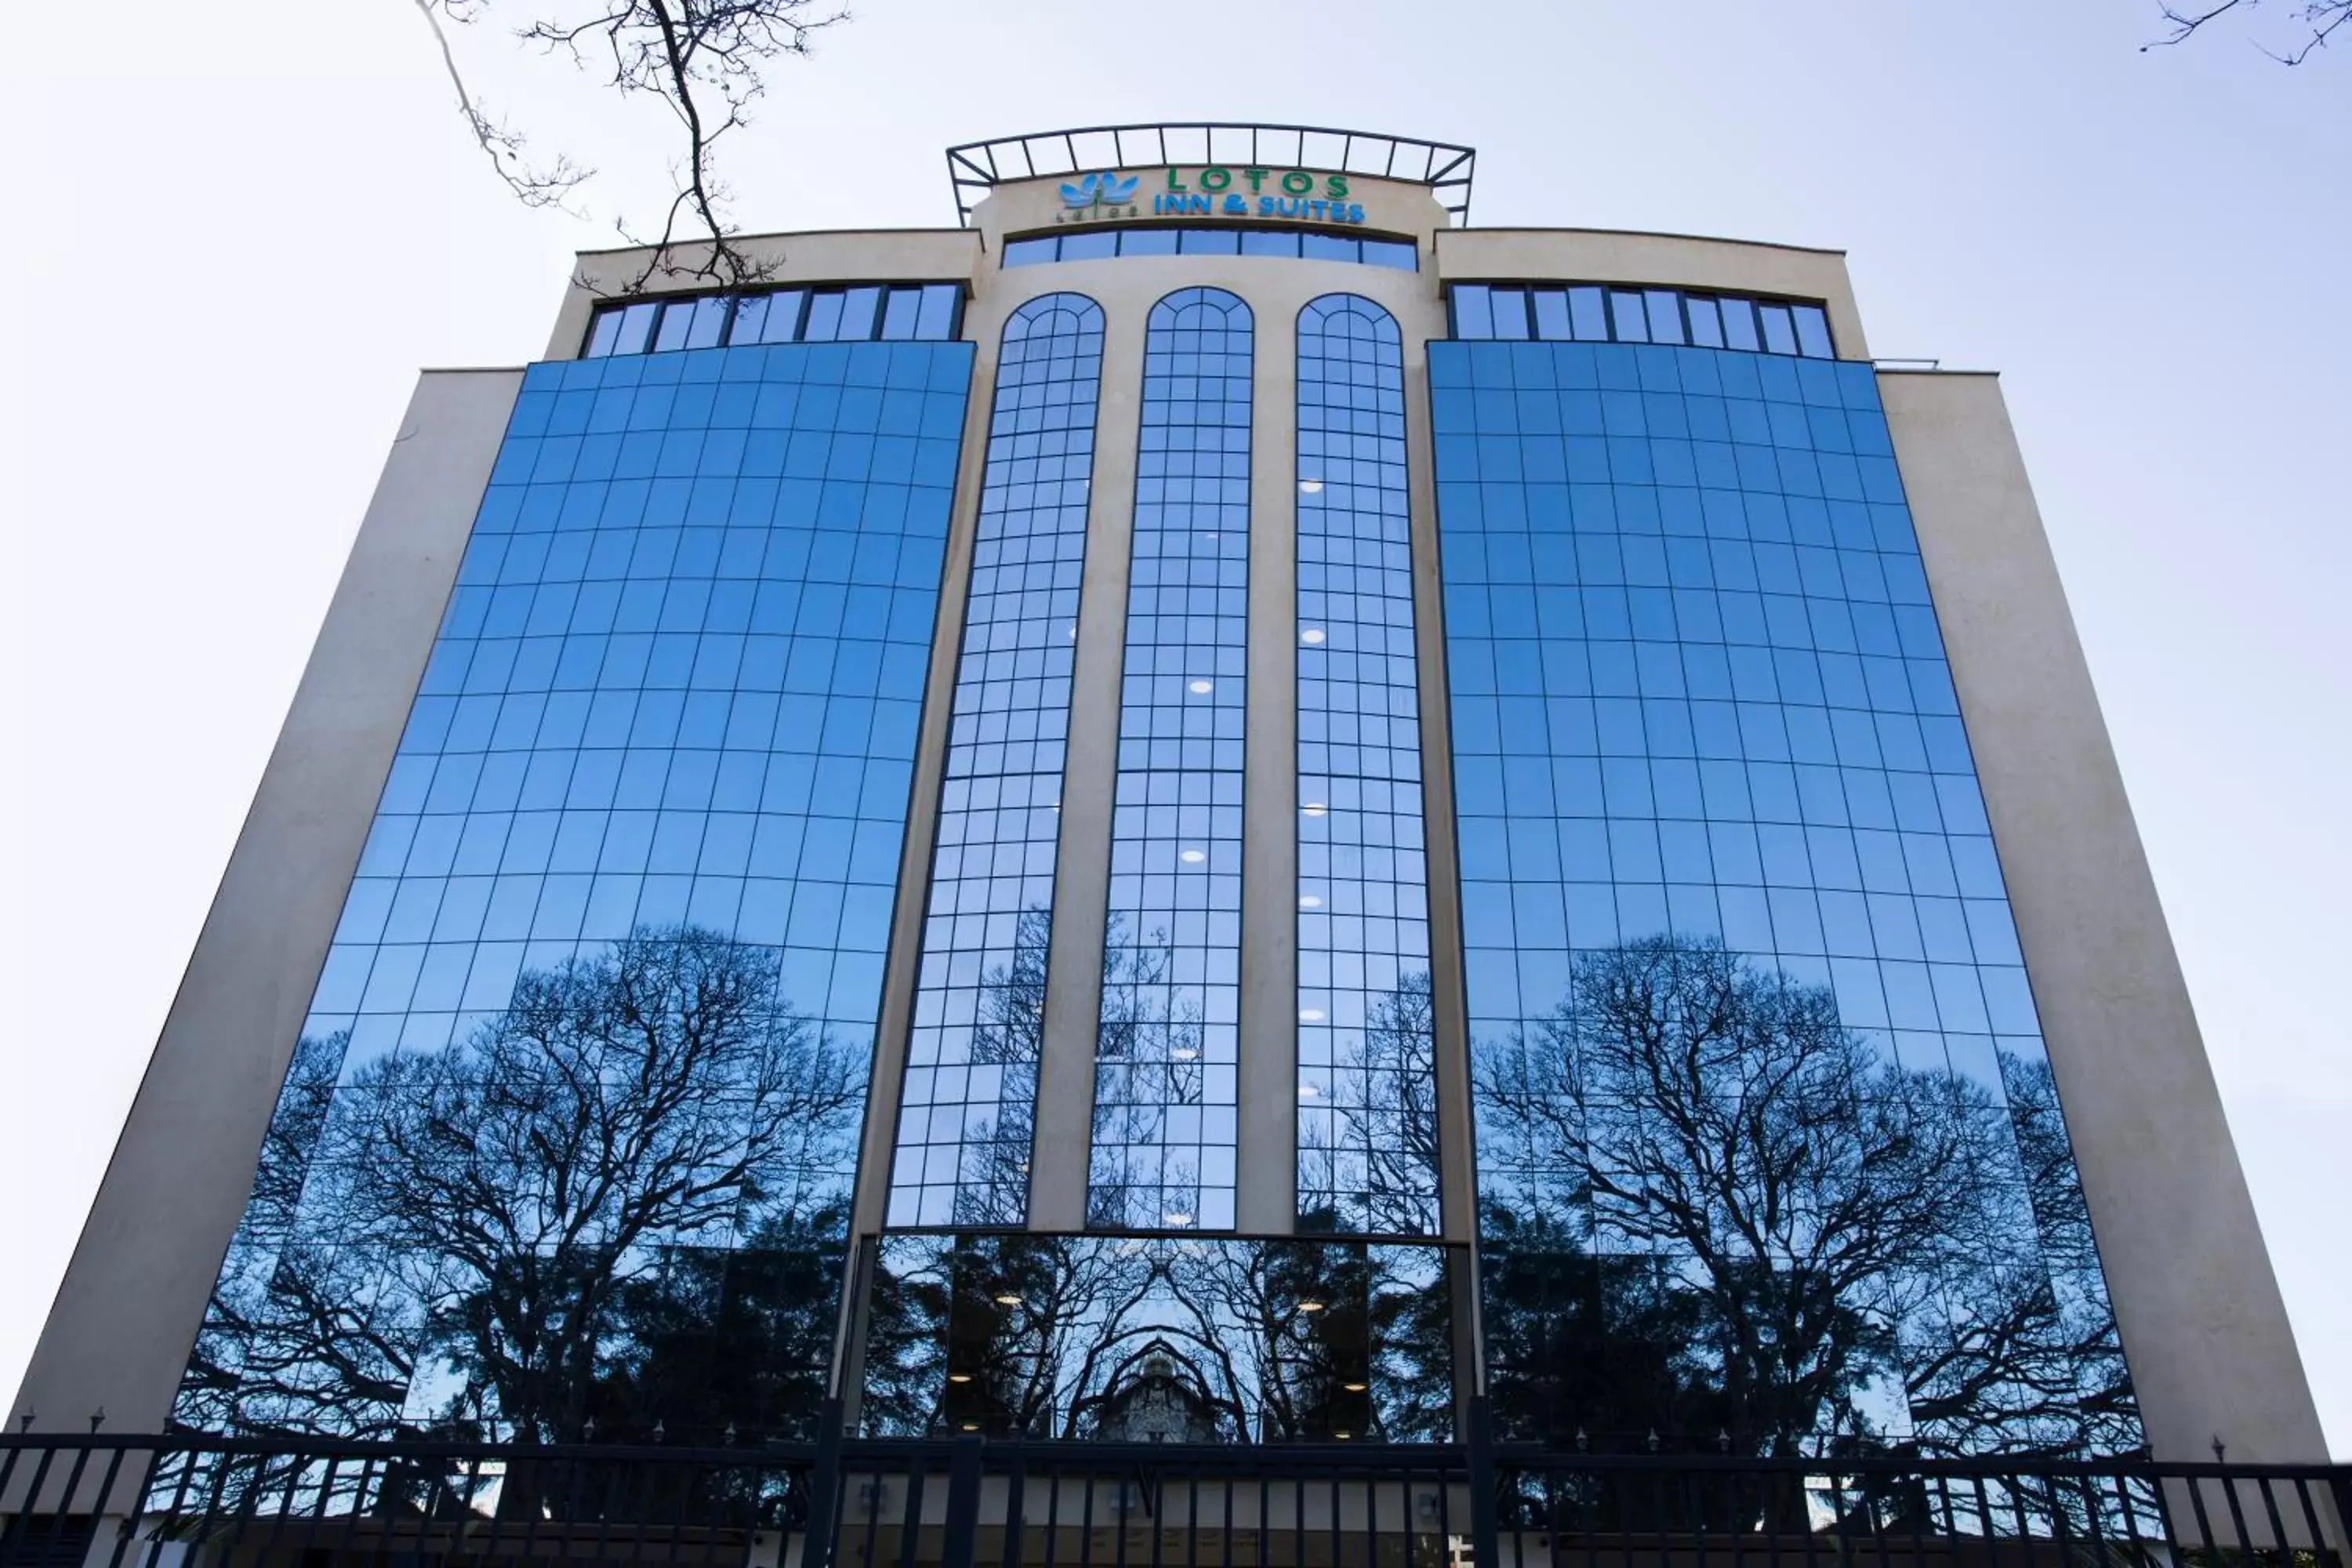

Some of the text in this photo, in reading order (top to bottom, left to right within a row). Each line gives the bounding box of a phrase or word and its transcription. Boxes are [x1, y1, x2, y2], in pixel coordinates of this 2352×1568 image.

[1167, 165, 1349, 198] LOTOS
[1154, 193, 1366, 223] INN & SUITES
